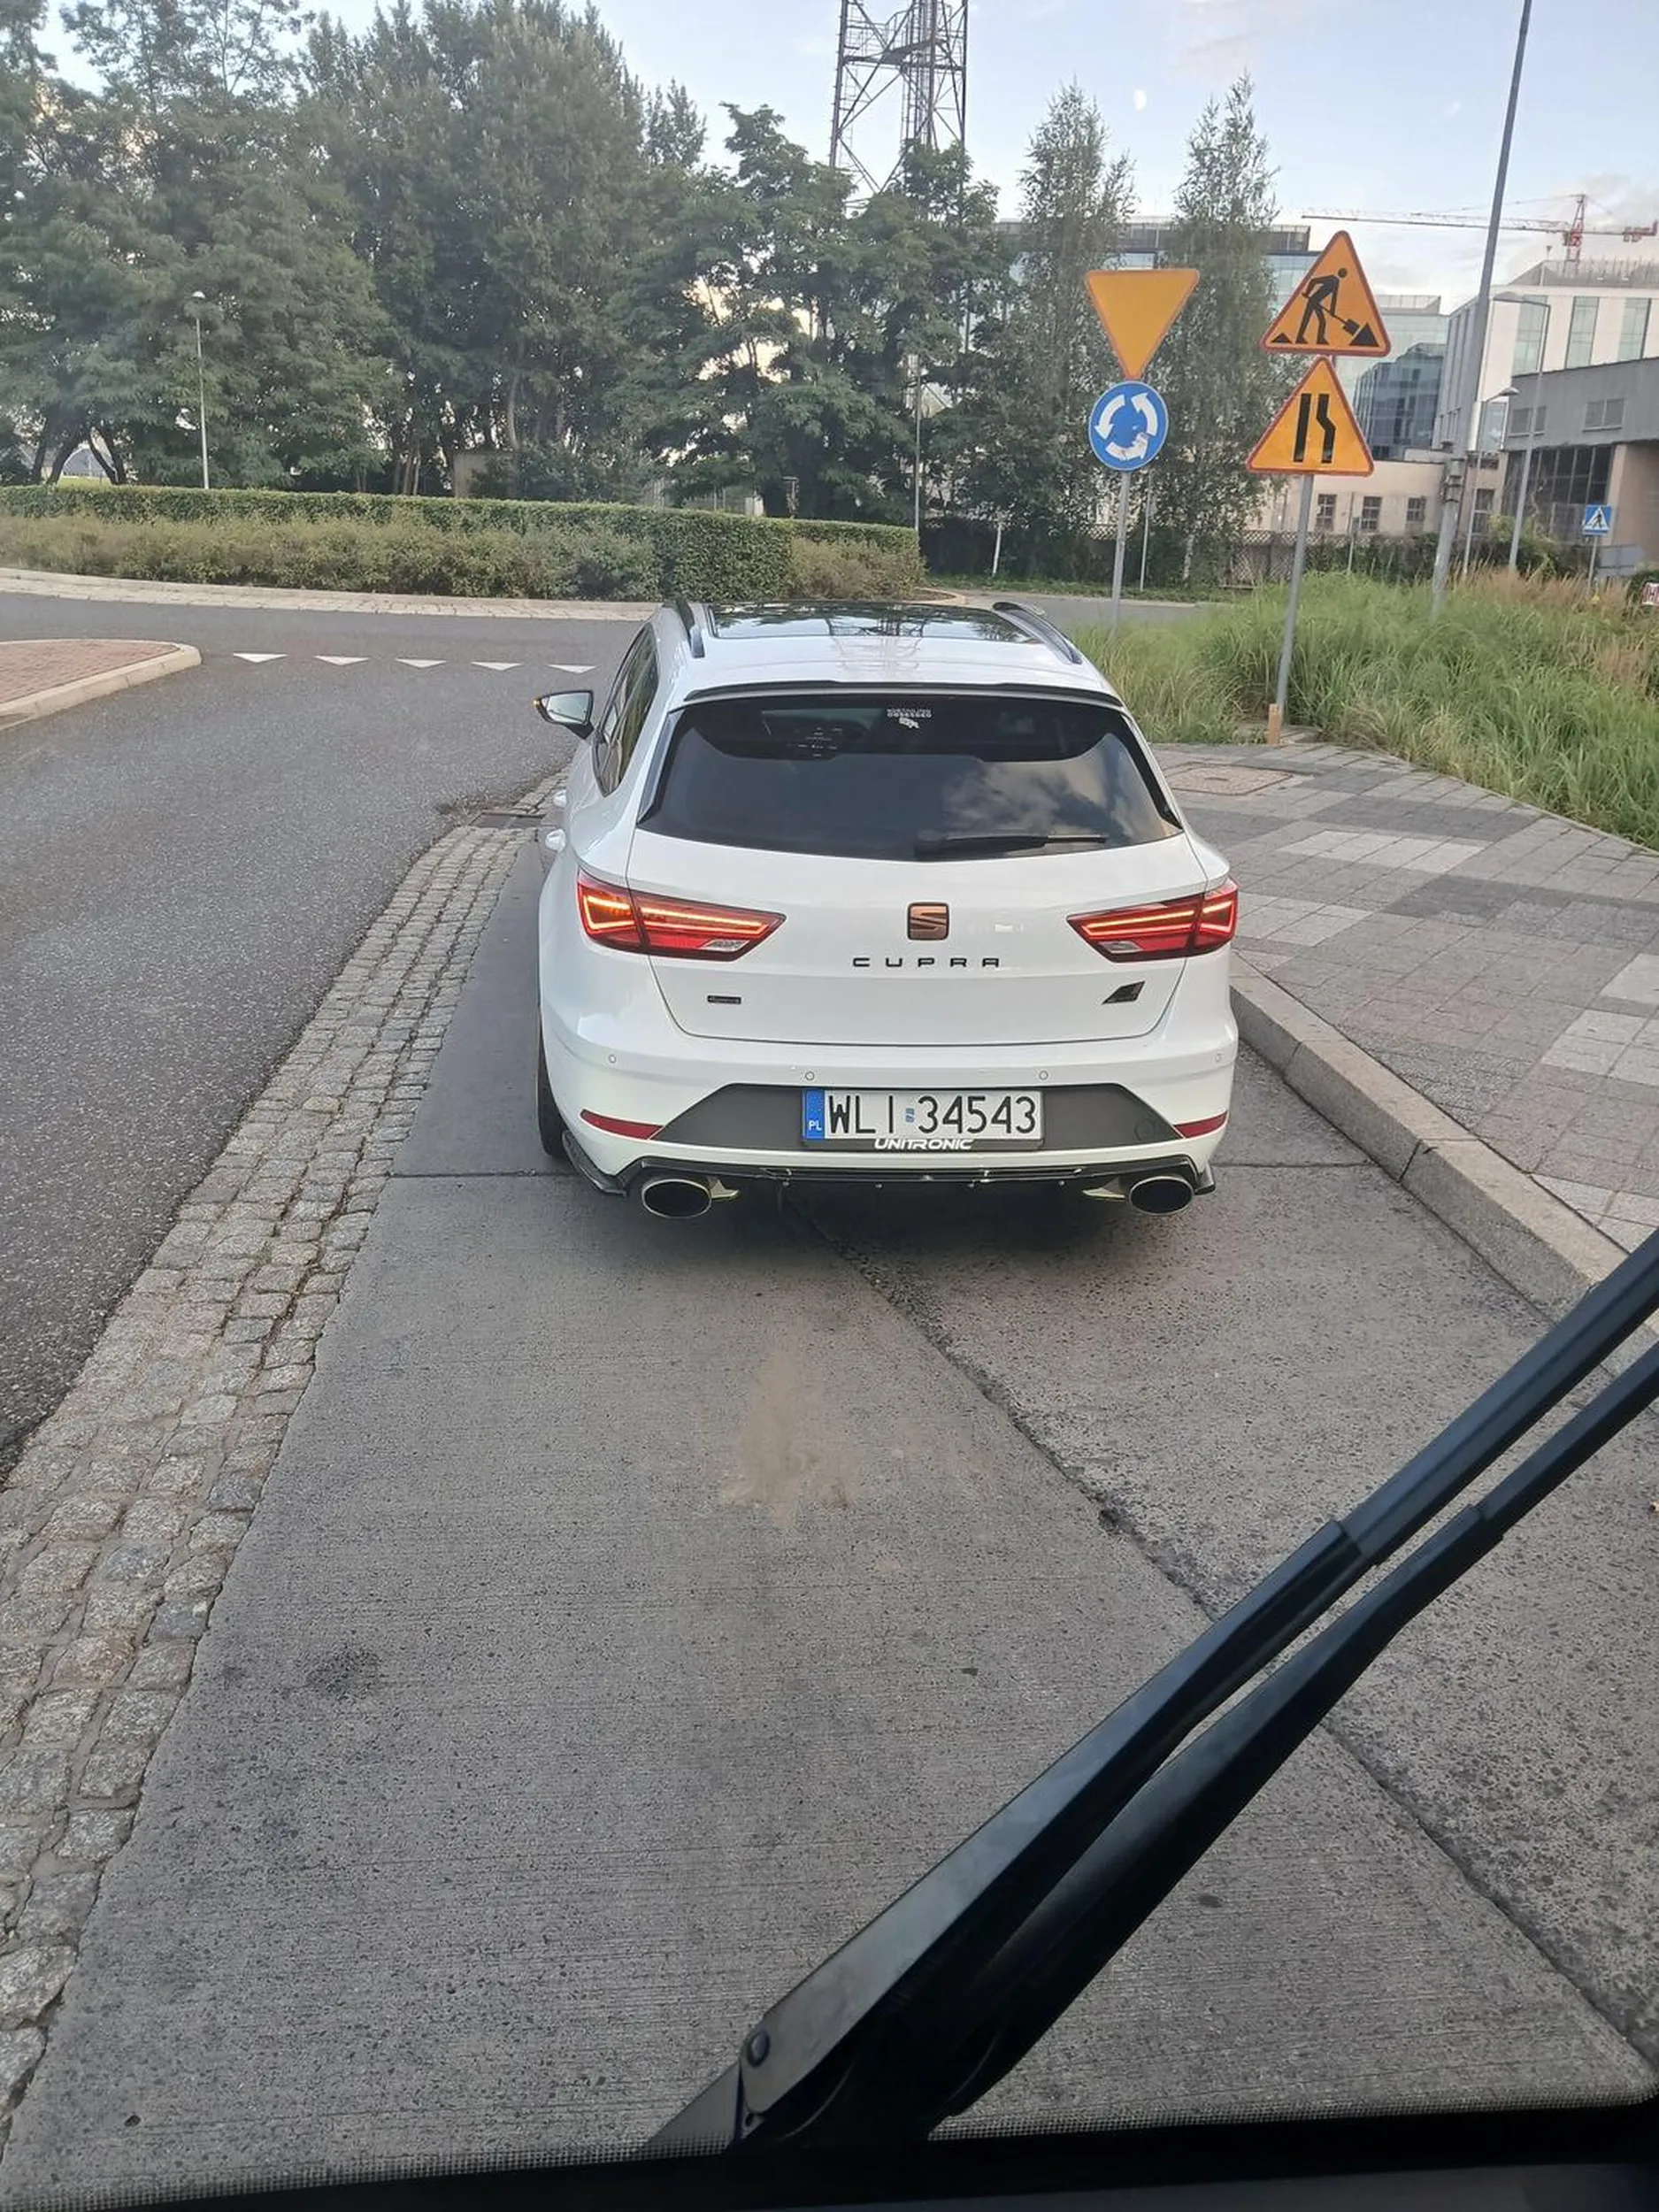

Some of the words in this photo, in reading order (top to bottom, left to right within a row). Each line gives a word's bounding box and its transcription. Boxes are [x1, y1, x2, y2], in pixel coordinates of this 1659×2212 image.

[852, 957, 1000, 968] CUPRA
[828, 1094, 894, 1133] WLI
[918, 1094, 1036, 1134] 34543
[809, 1120, 822, 1131] PL
[874, 1138, 974, 1150] UNITRONIC
